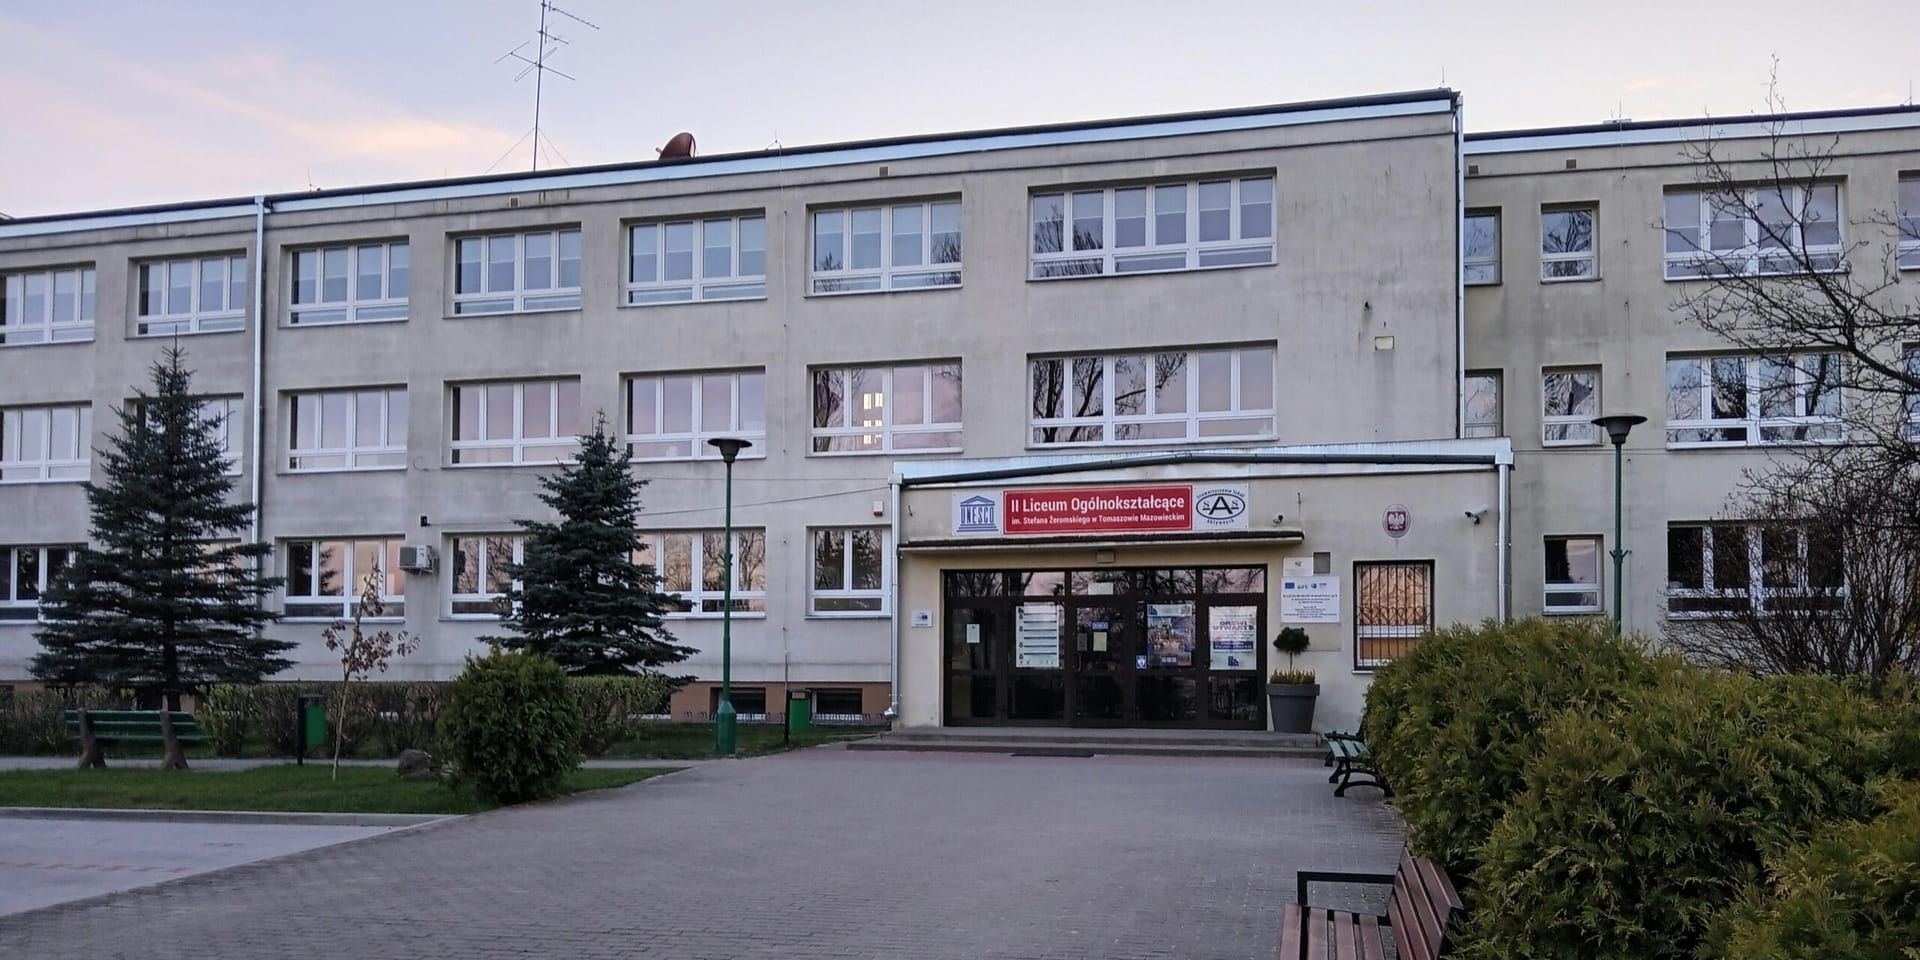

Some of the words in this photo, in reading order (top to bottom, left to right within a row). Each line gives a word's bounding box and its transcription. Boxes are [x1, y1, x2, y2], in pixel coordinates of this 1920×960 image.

[1011, 499, 1019, 513] II
[1023, 498, 1067, 512] Liceum
[1071, 494, 1185, 513] Ogólnokształcące
[1209, 496, 1233, 515] A
[960, 506, 995, 524] UNESCO
[1011, 516, 1022, 525] im.
[1023, 516, 1048, 525] Stefana
[1049, 514, 1091, 525] Żeromskiego
[1140, 513, 1185, 521] Mazowieckim
